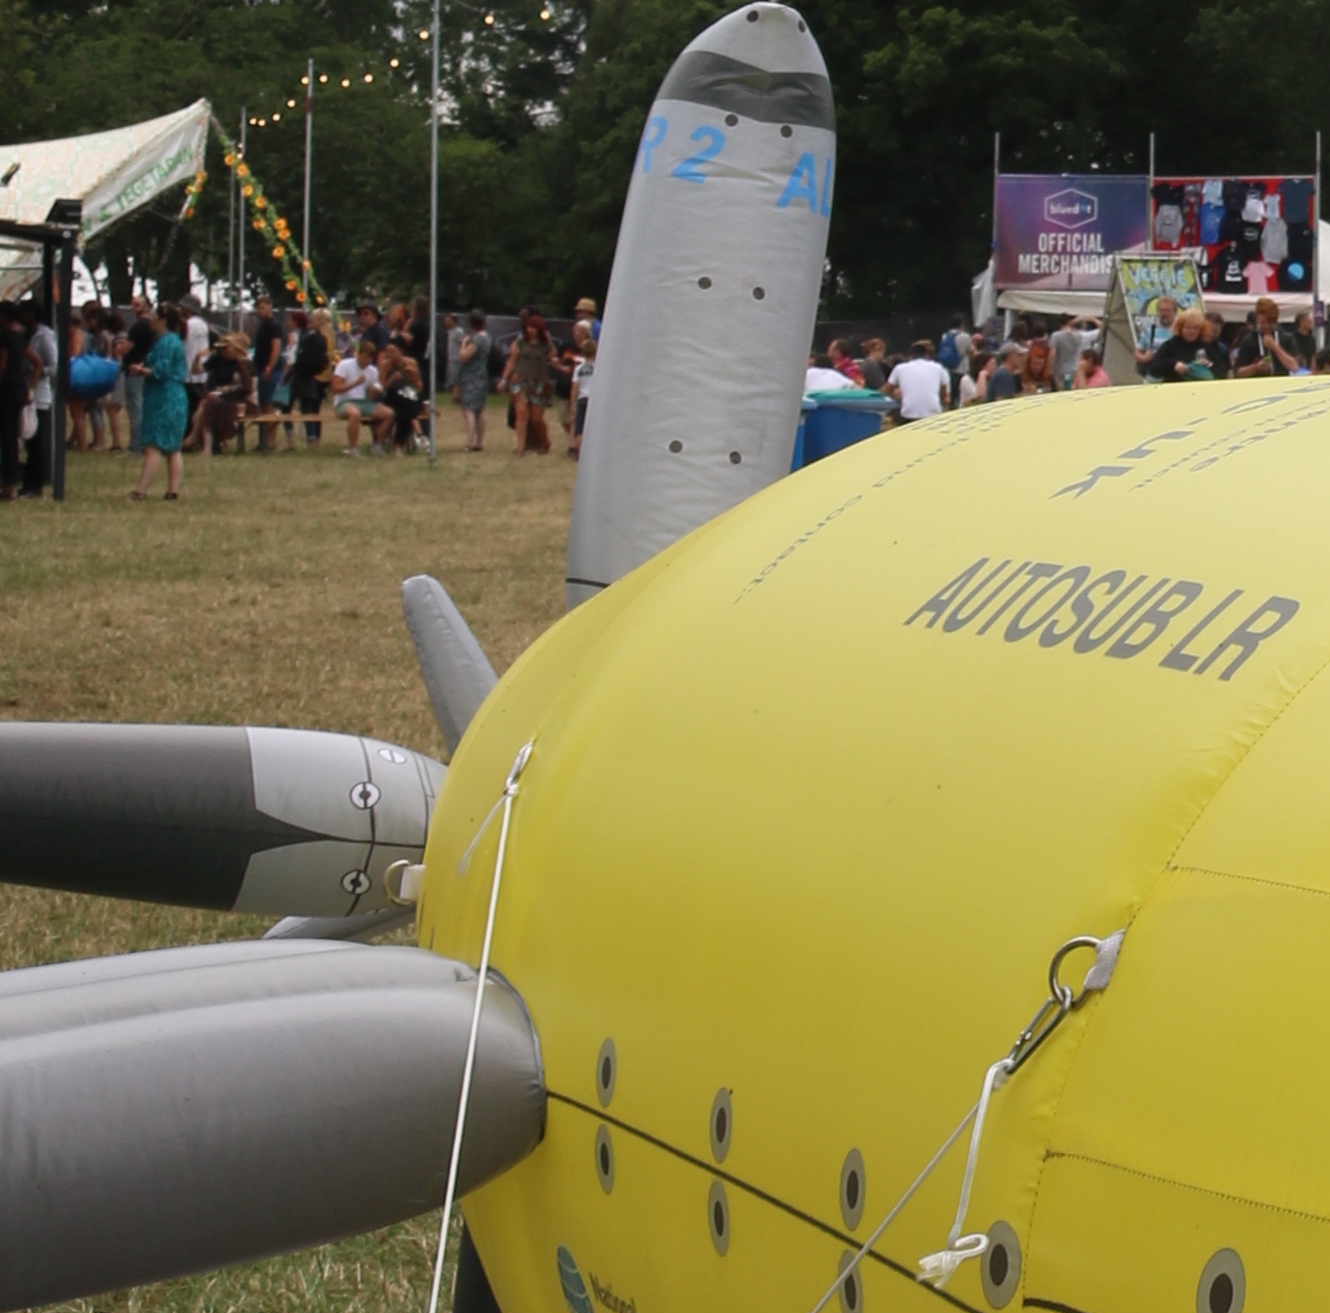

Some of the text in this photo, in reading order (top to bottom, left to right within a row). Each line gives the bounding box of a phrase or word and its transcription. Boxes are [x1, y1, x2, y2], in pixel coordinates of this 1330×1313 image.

[671, 125, 726, 184] 2
[1037, 233, 1104, 253] OFFICIAL
[1018, 253, 1114, 275] MERCHANDIS
[902, 557, 1301, 682] AUTOSUB LR
